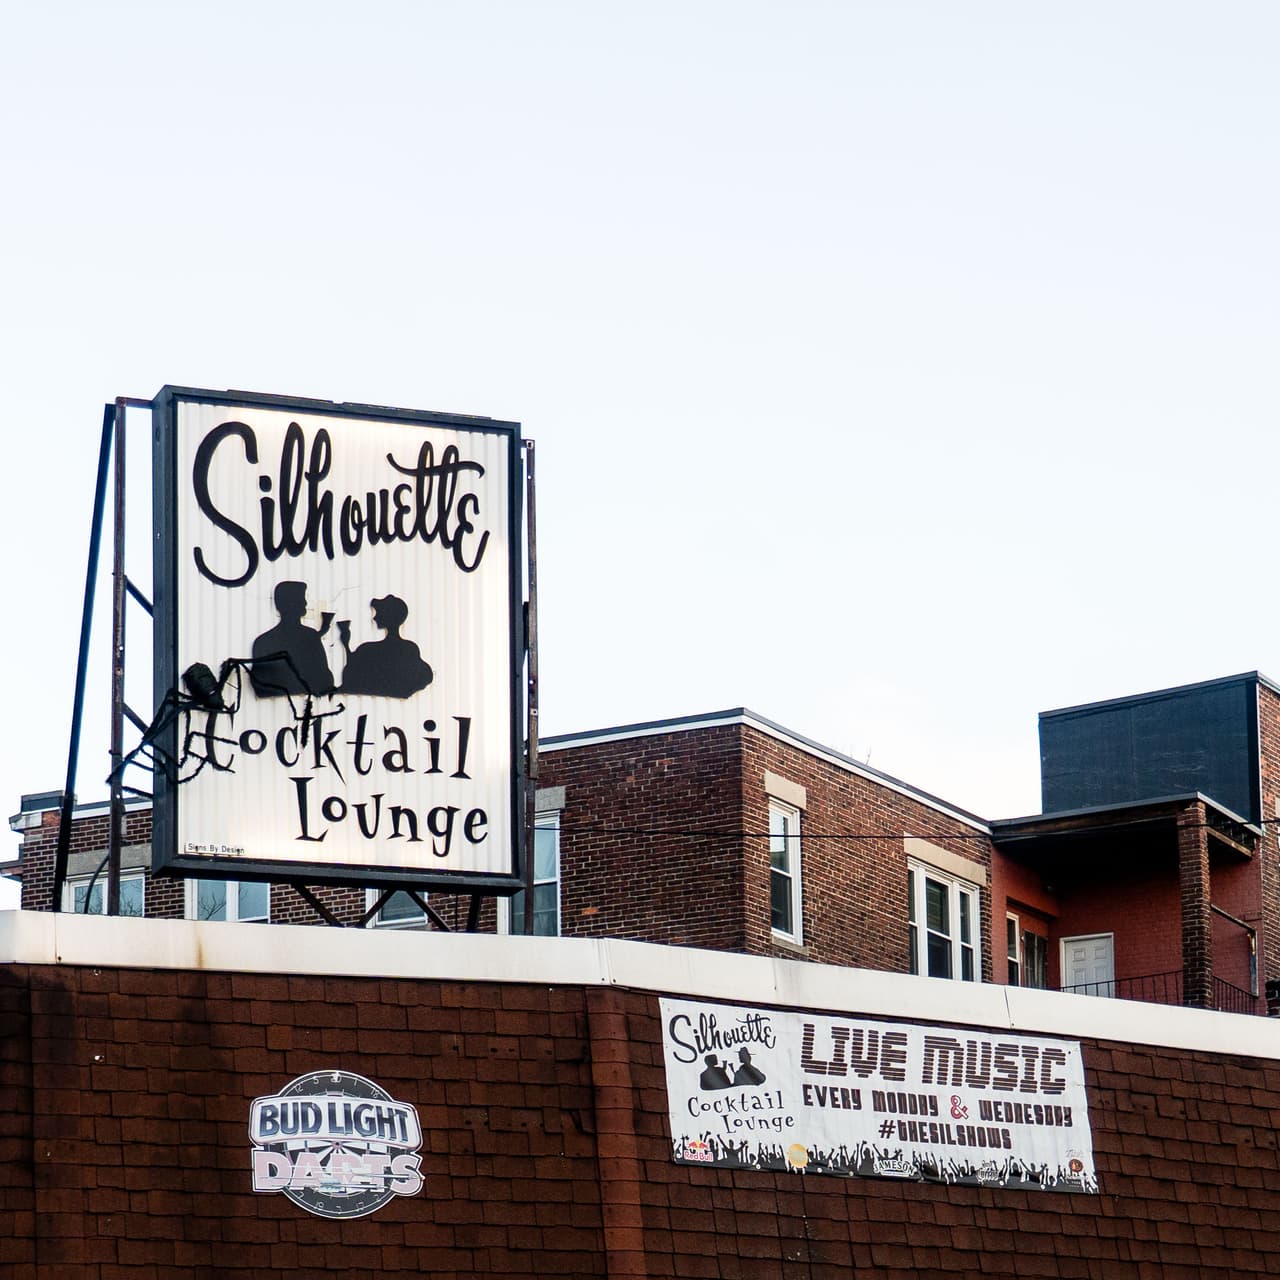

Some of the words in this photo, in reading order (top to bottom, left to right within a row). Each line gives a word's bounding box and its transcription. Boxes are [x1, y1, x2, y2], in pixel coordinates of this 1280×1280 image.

[193, 421, 490, 588] Silhouette
[204, 713, 473, 784] Cocktail
[289, 776, 490, 858] Lounge
[669, 1014, 777, 1065] Silhouette
[800, 1023, 909, 1083] LIVE
[921, 1035, 1067, 1096] MUSIC
[259, 1102, 323, 1138] BUD
[328, 1102, 409, 1142] LIGHT
[687, 1089, 785, 1119] Cocktail
[720, 1112, 796, 1136] Lounge
[802, 1083, 863, 1111] EVERY
[871, 1089, 940, 1118] MONDAY
[949, 1094, 970, 1121] &
[977, 1098, 1074, 1128] WEDNESDAY
[253, 1151, 421, 1195] DARTS
[683, 1150, 698, 1162] Red
[699, 1150, 714, 1163] Bull
[872, 1159, 917, 1176] JAMESON
